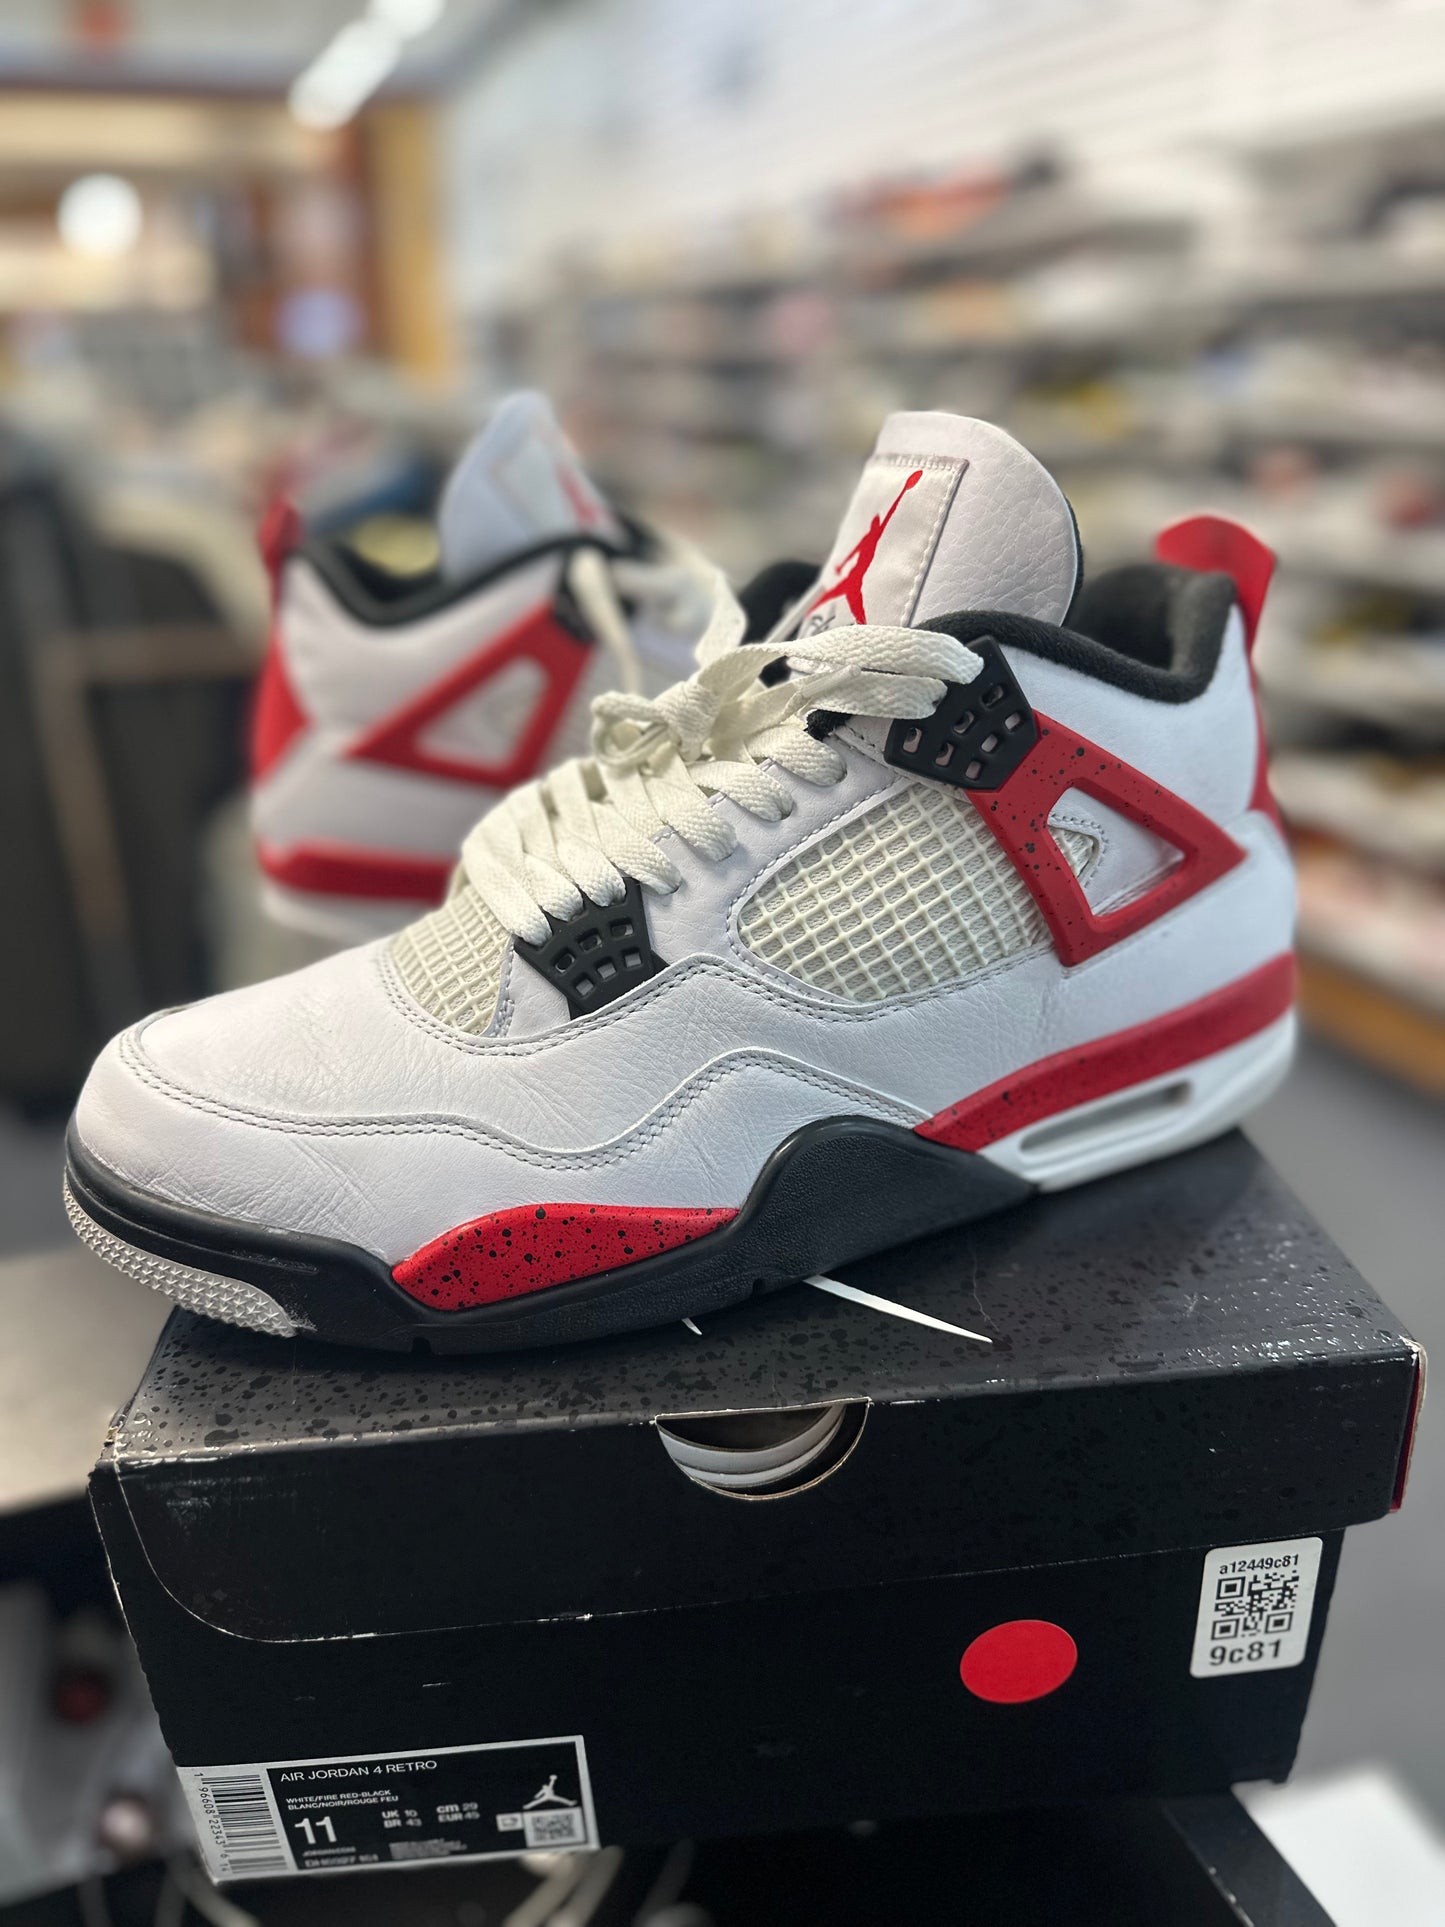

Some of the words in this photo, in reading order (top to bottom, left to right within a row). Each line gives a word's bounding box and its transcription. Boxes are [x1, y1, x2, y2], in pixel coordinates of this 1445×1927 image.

[1219, 1553, 1299, 1575] a12449c81
[1209, 1639, 1281, 1666] 9c81
[280, 1772, 305, 1783] AIR
[308, 1767, 370, 1781] JORDAN
[373, 1765, 383, 1775] 4
[386, 1760, 438, 1773] RETRO
[286, 1793, 339, 1804] WHITE/FIRE
[339, 1789, 391, 1800] RED-BLACK
[288, 1797, 380, 1811] BLANC/NOIR/ROUGE
[380, 1795, 399, 1803] FEU
[199, 1787, 215, 1815] 96608
[208, 1819, 226, 1846] 22343
[381, 1810, 400, 1819] UK
[404, 1809, 418, 1818] 10
[436, 1804, 460, 1813] cm
[438, 1812, 464, 1823] EUR
[294, 1816, 338, 1845] 11
